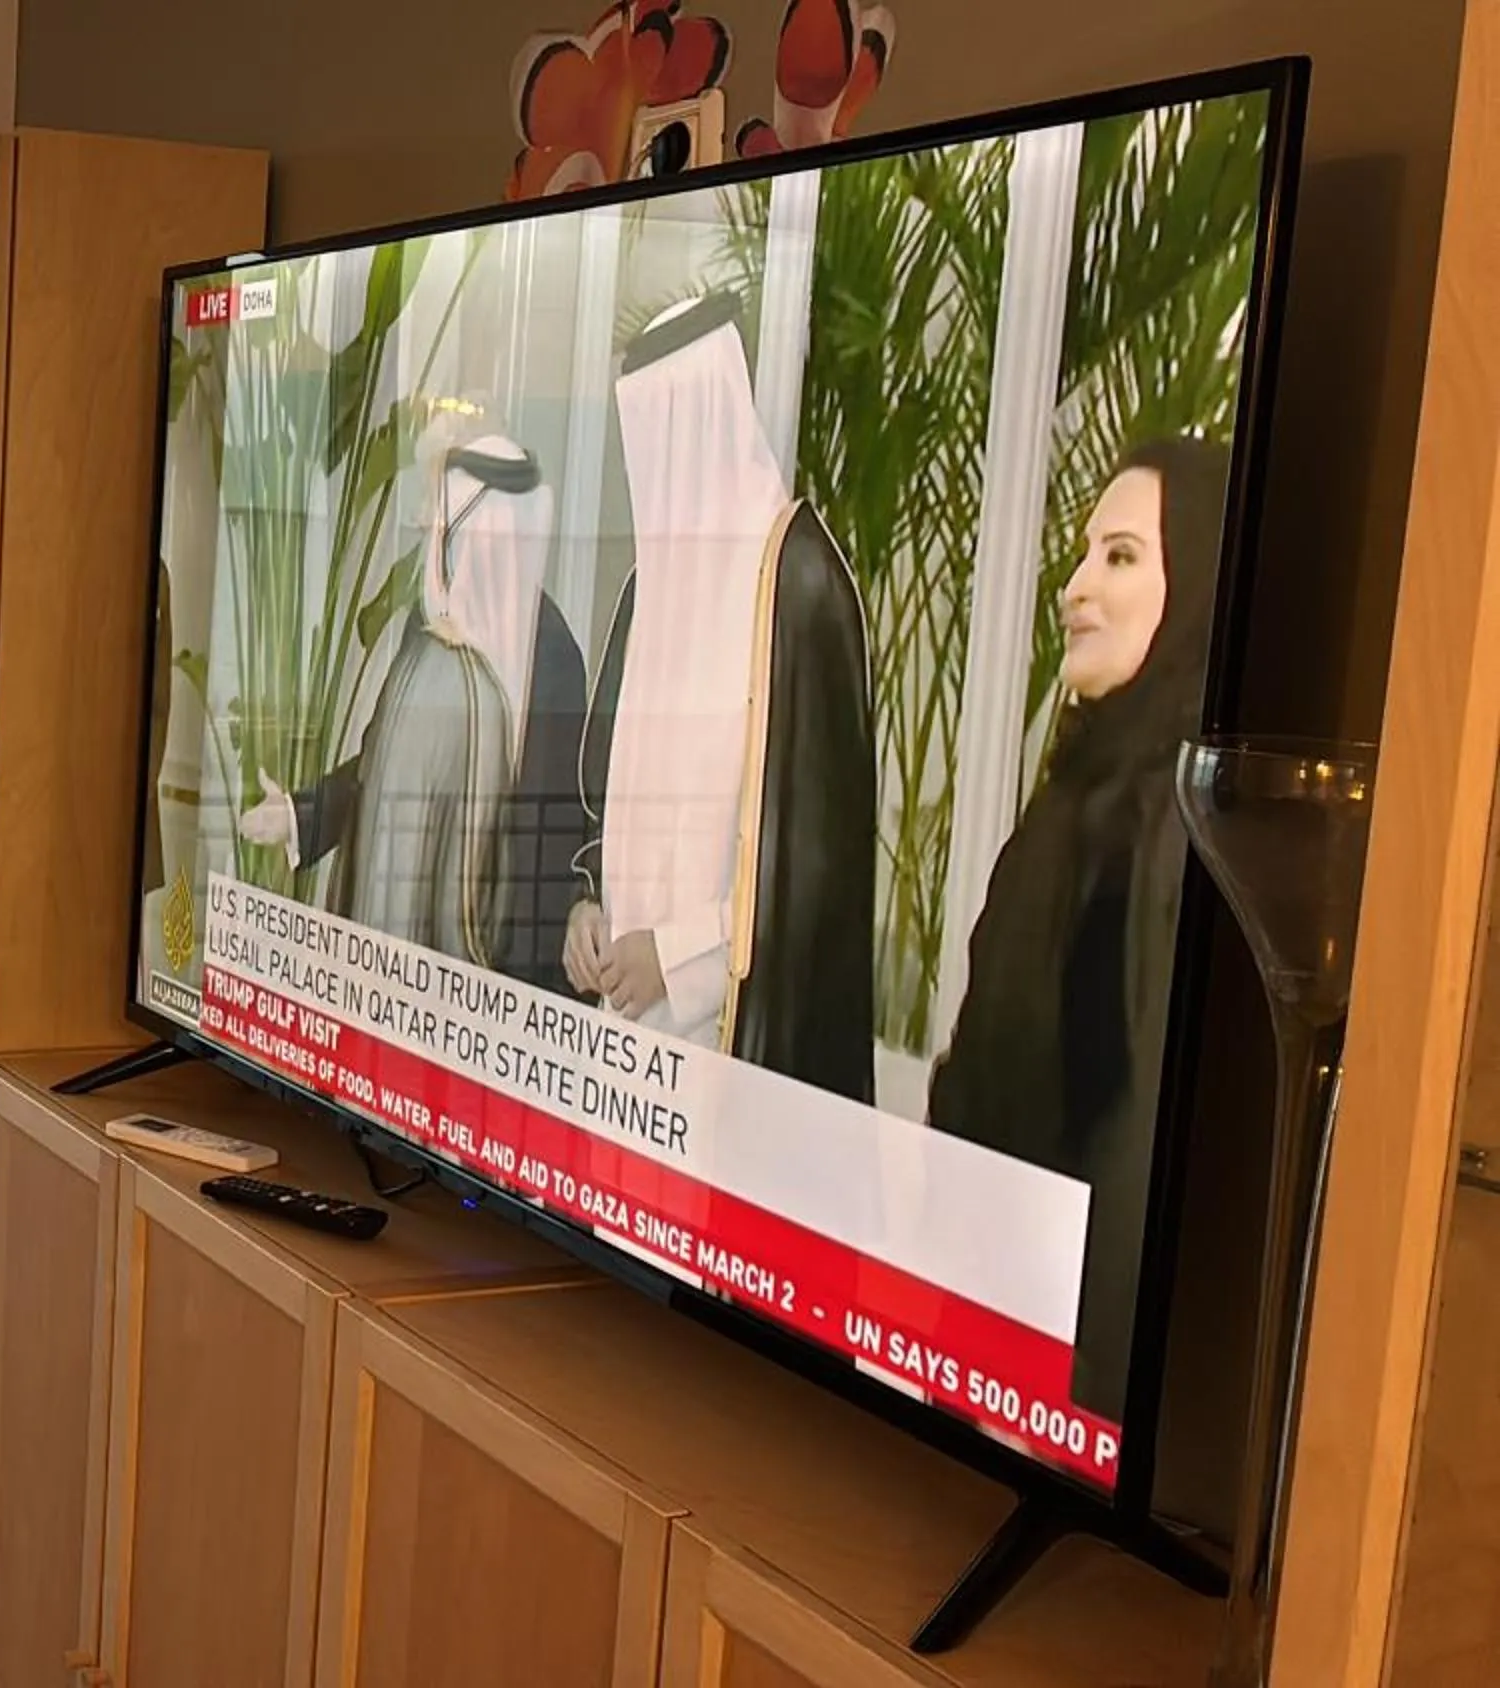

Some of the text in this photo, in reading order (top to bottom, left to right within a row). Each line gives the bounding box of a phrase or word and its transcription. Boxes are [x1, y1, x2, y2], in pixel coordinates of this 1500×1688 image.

[199, 291, 228, 320] LIVE
[243, 287, 273, 312] DOHA
[205, 969, 341, 1051] TRUMP GULF VISIT
[209, 924, 688, 1156] LUSAIL PALACE IN QATAR FOR STATE DINNER
[211, 884, 240, 921] U.S.
[245, 896, 343, 960] PRESIDENT
[347, 933, 431, 993] DONALD
[436, 965, 518, 1025] TRUMP
[523, 1000, 637, 1074] ARRIVES
[645, 1044, 685, 1092] AT
[225, 1014, 247, 1043] ALL
[250, 1024, 316, 1075] DELIVERIES
[318, 1057, 337, 1083] OF
[338, 1066, 377, 1109] FOOD,
[381, 1087, 434, 1137] WATER,
[438, 1115, 477, 1155] FUEL
[479, 1137, 515, 1173] AND
[518, 1155, 548, 1189] AID
[553, 1169, 575, 1203] TO
[579, 1183, 629, 1233] GAZA
[633, 1209, 693, 1262] SINCE
[697, 1238, 775, 1303] MARCH
[780, 1280, 795, 1313] 2
[844, 1309, 881, 1354] UN
[887, 1330, 959, 1392] SAYS
[967, 1368, 1086, 1455] 500,000
[1094, 1430, 1118, 1467] P
